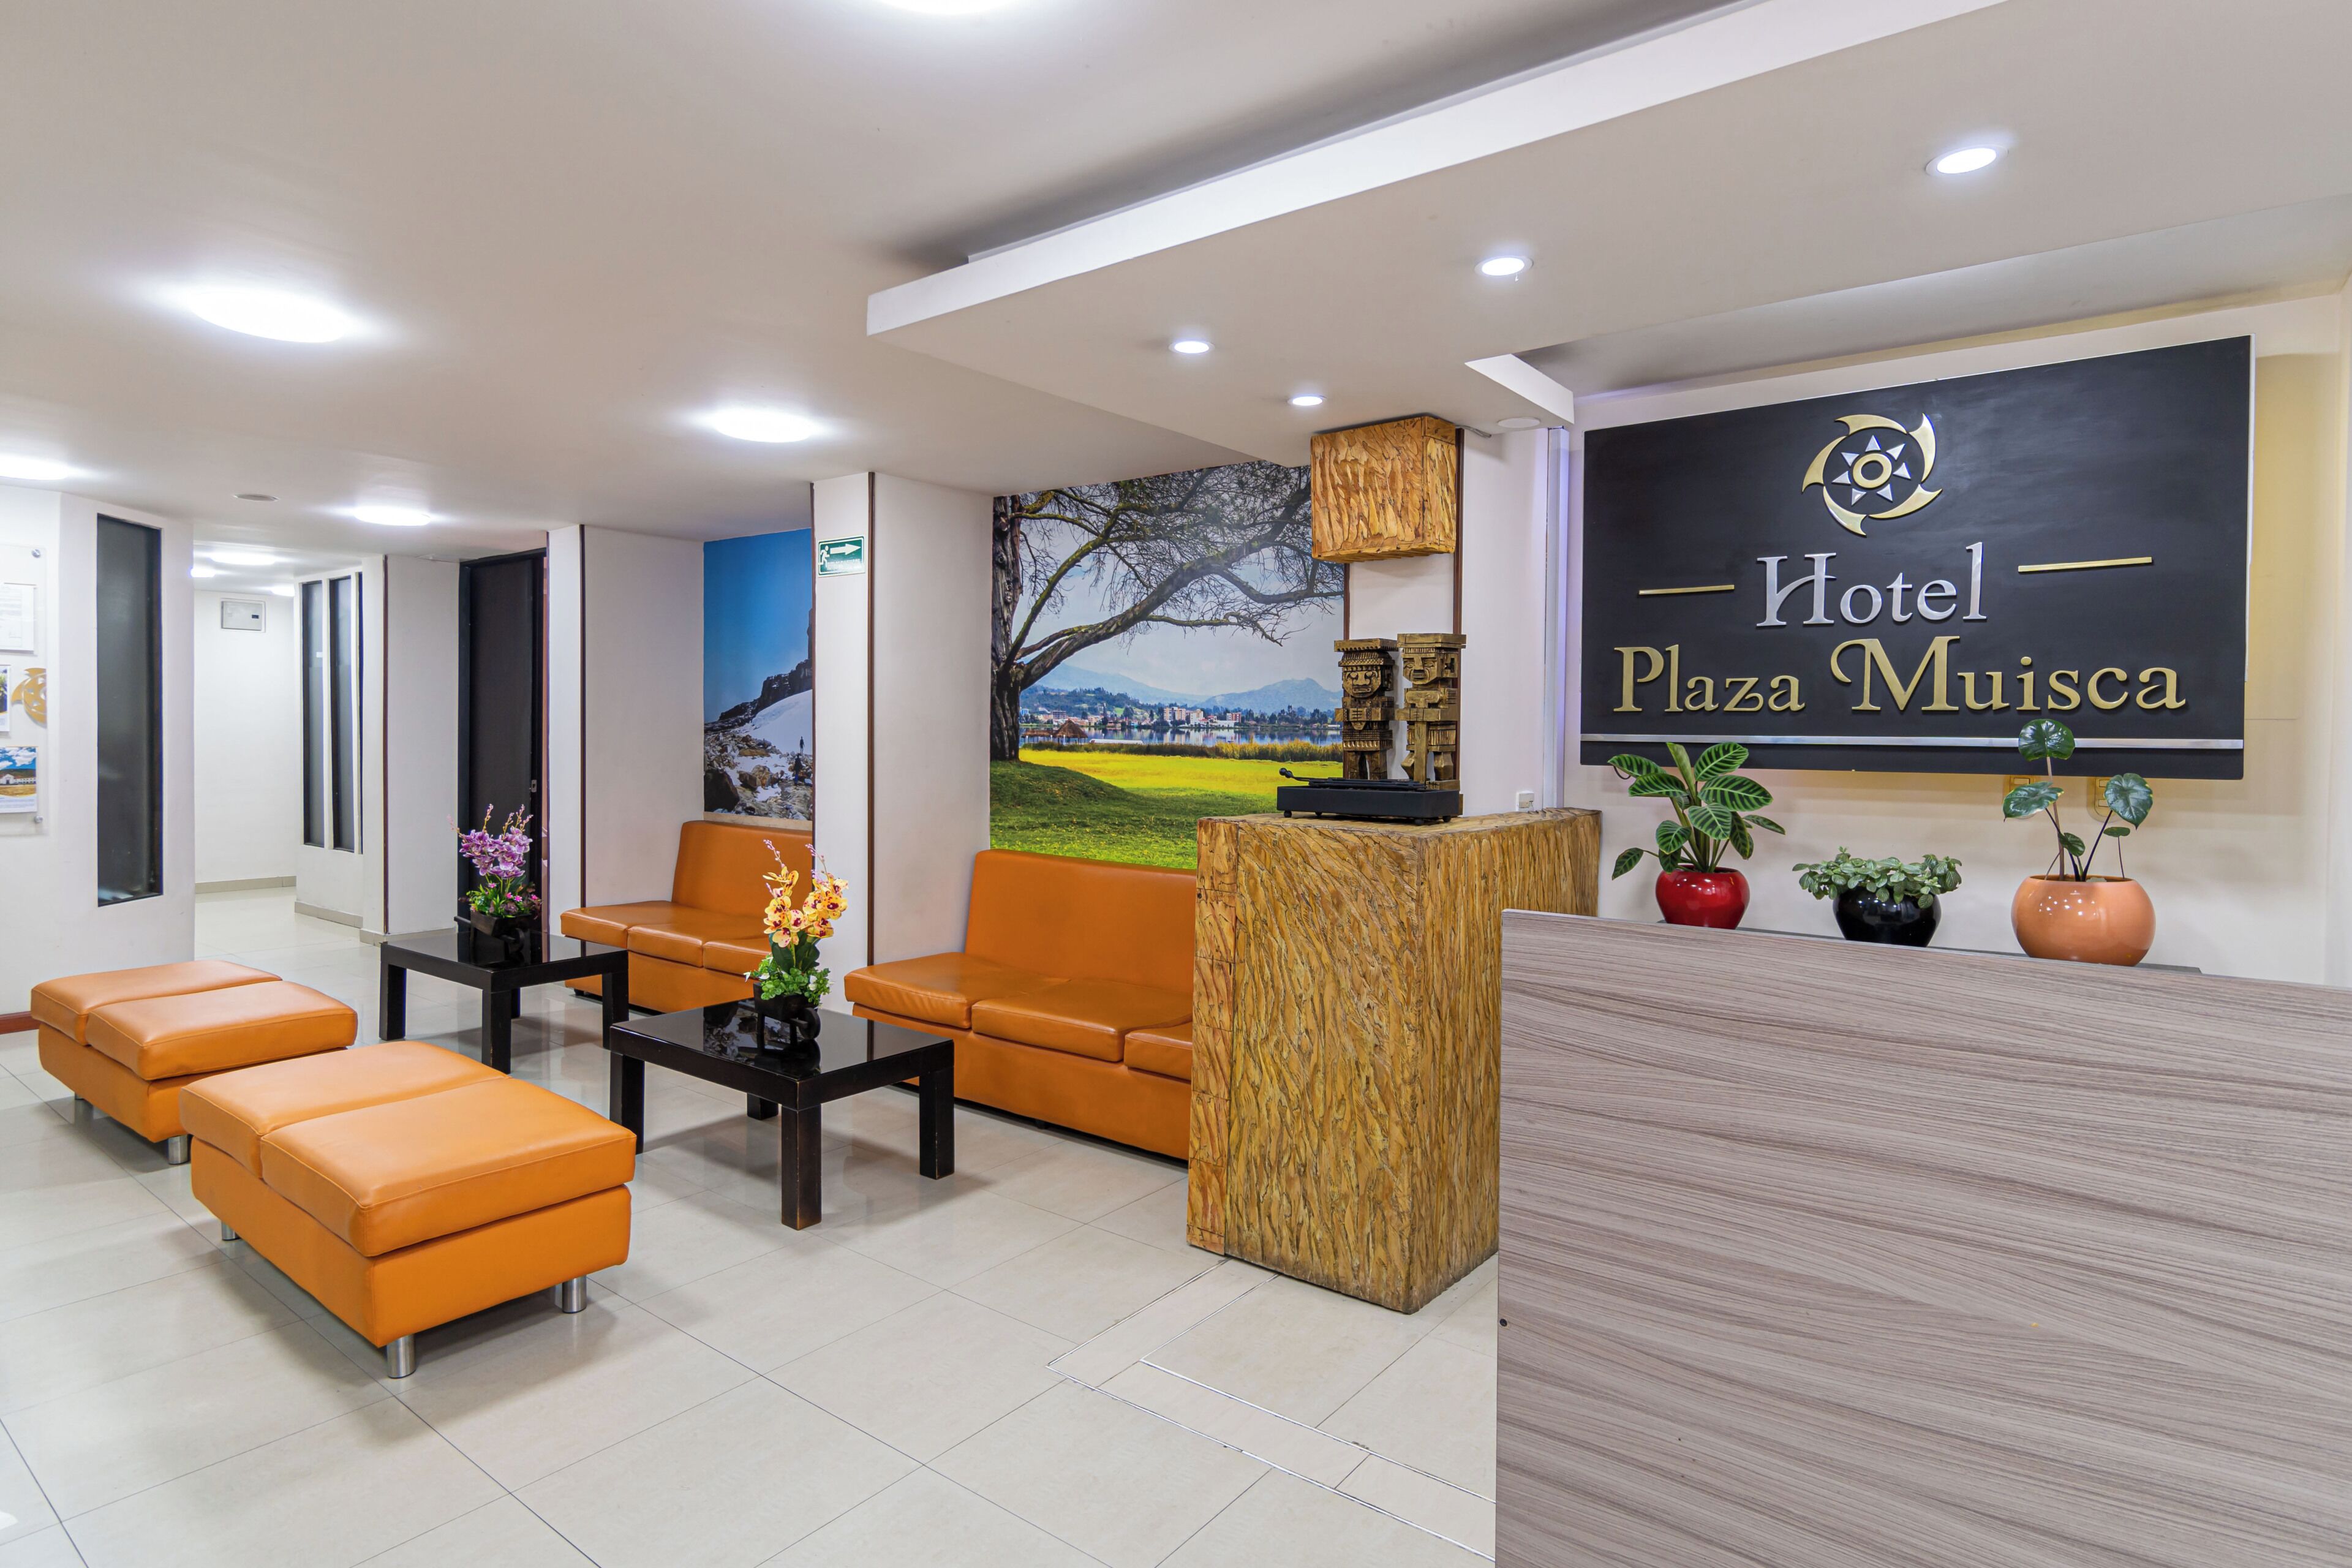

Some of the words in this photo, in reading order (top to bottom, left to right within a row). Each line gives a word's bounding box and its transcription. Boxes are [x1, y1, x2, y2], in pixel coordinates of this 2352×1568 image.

[1756, 541, 1988, 627] Hotel
[1613, 645, 1806, 712] Plaza
[1830, 635, 2187, 711] Muisca
